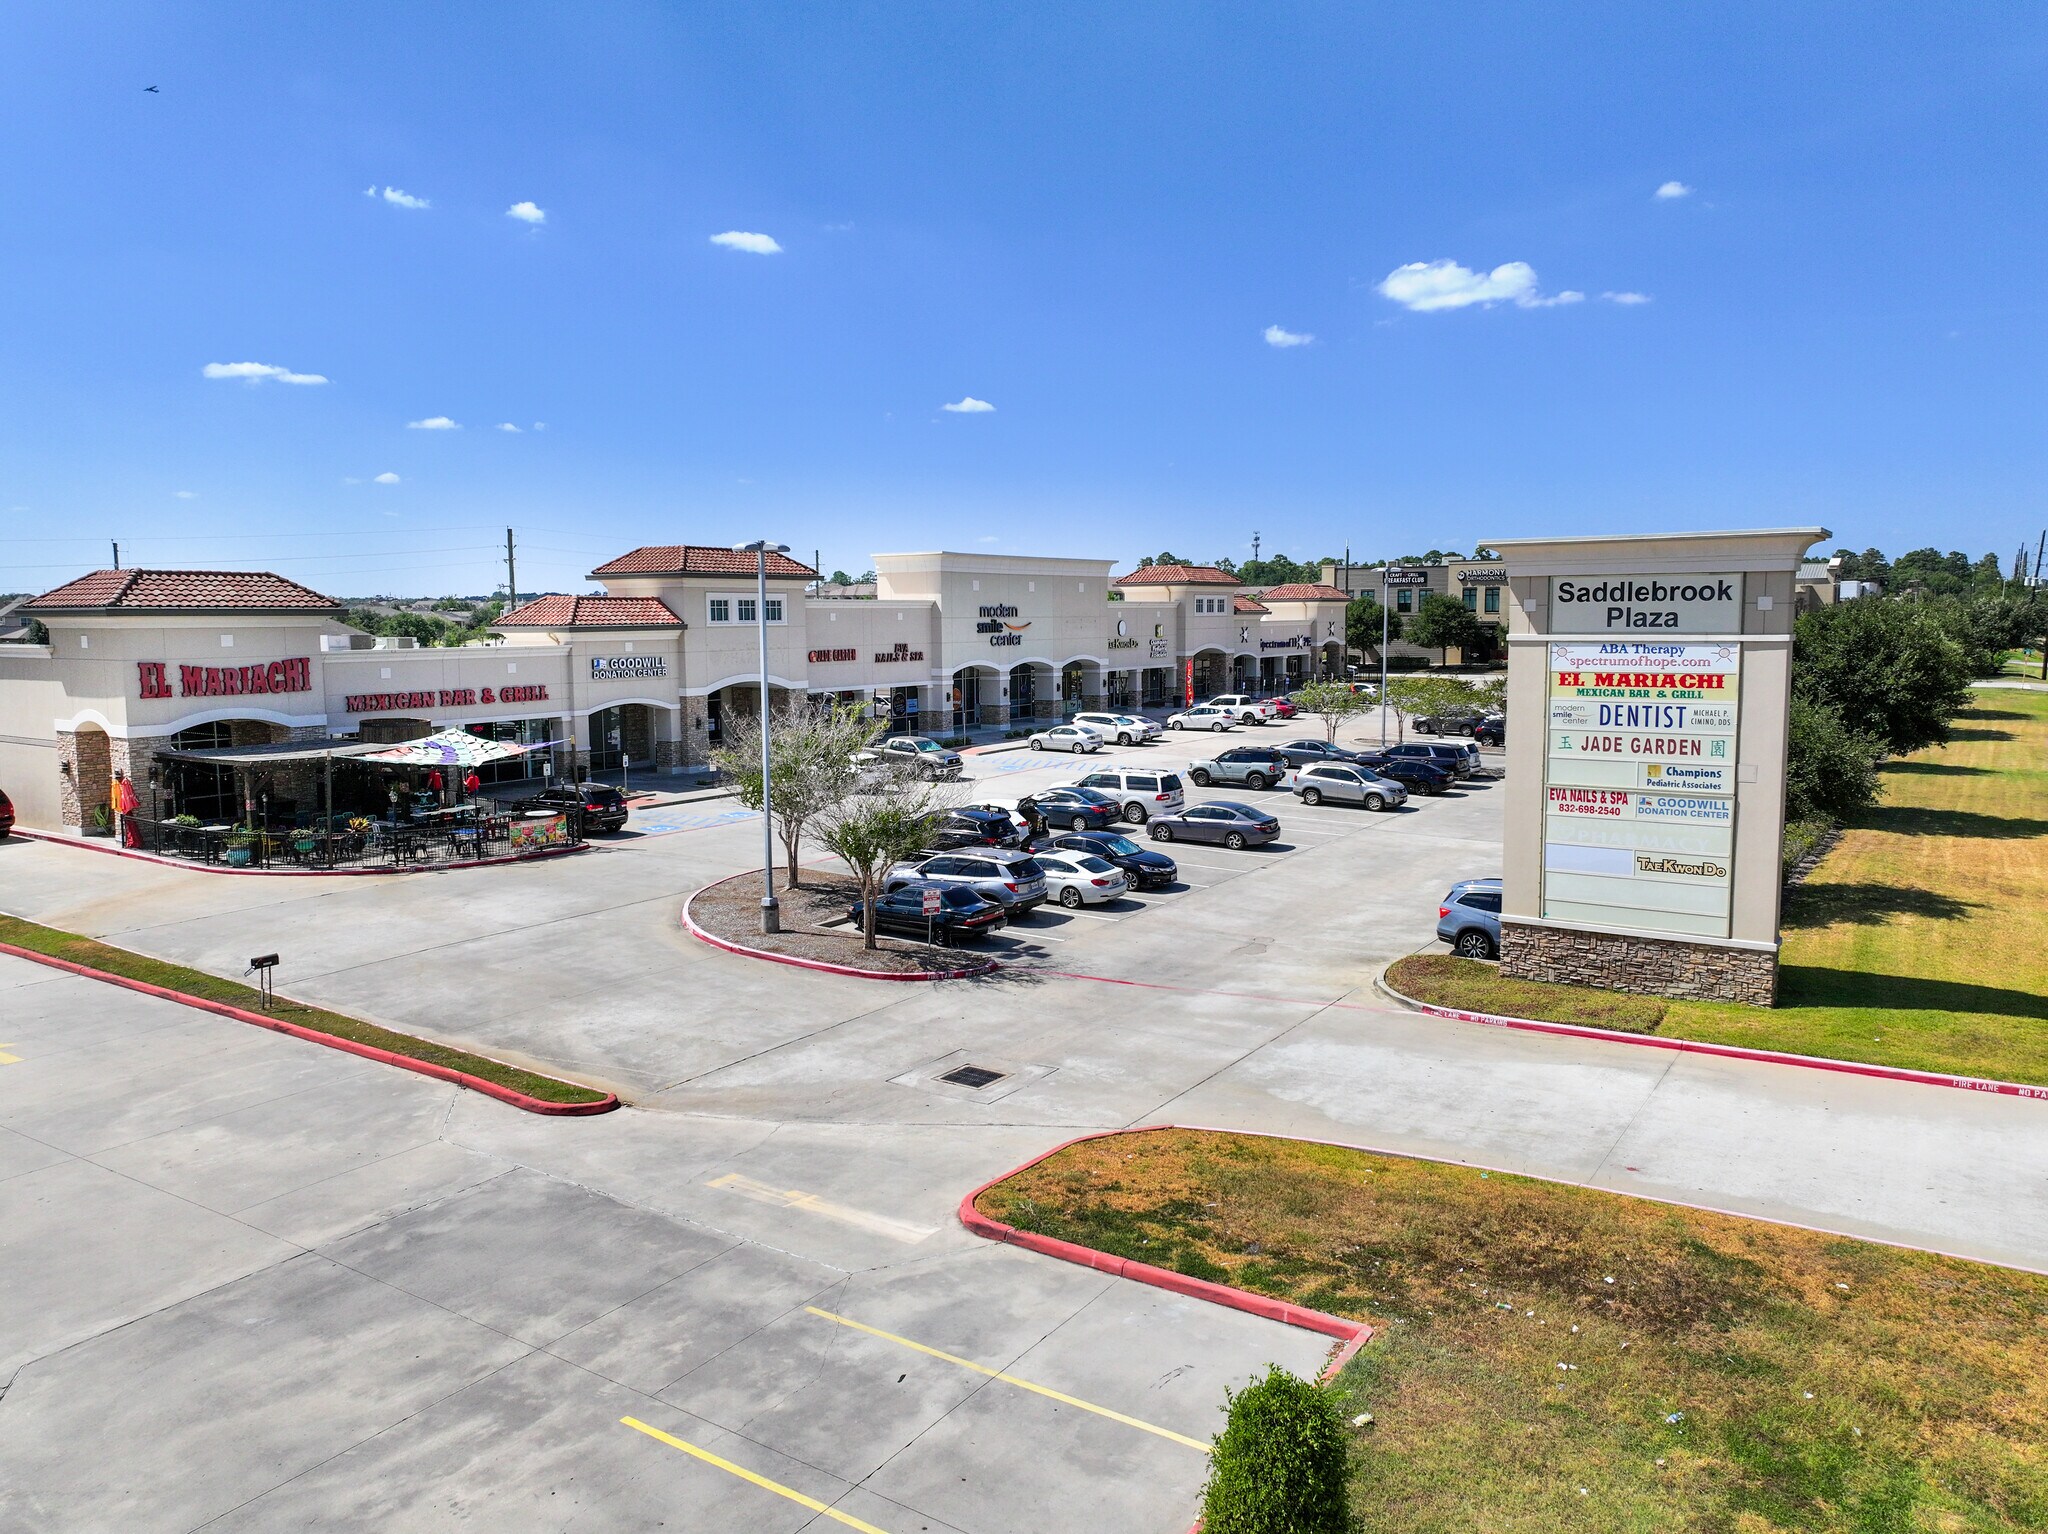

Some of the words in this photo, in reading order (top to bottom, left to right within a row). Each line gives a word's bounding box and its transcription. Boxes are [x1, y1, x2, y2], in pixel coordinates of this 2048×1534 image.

[1466, 568, 1506, 577] HARMONY
[1558, 580, 1733, 603] Saddlebrook
[979, 603, 1018, 618] modern
[1607, 607, 1679, 628] Plaza
[976, 619, 1003, 633] smile
[990, 632, 1022, 646] center
[1599, 644, 1628, 654] ABA
[1631, 644, 1686, 657] Therapy
[609, 656, 668, 669] GOODWILL
[1570, 655, 1711, 670] spectrumofhope.com
[137, 661, 173, 699] EL
[179, 657, 312, 697] MARIACHI
[592, 669, 636, 680] DONATION
[637, 667, 668, 678] CENTER
[1558, 672, 1585, 687] EL
[1594, 673, 1725, 689] MARIACHI
[345, 690, 436, 712] MEXICAN
[439, 688, 477, 707] BAR
[481, 687, 496, 704] &
[500, 685, 550, 703] GRILL
[1576, 688, 1625, 698] MEXICAN
[1629, 689, 1650, 698] BAR
[1656, 690, 1667, 698] &
[1671, 689, 1704, 699] GRILL
[1554, 704, 1586, 712] modern
[1693, 709, 1720, 717] MICHAEL
[1562, 717, 1588, 725] center
[1599, 704, 1687, 729] DENTIST
[1690, 717, 1717, 726] CIMINO,
[1718, 718, 1731, 726] DDS
[1558, 735, 1573, 750] 玉
[1581, 736, 1623, 752] JADE
[1631, 738, 1702, 756] GARDEN
[1666, 766, 1722, 779] Champions
[1646, 778, 1680, 788] Pediatric
[1682, 780, 1722, 790] Associates
[1550, 788, 1567, 801] EVA
[1570, 789, 1597, 804] NAILS
[1600, 790, 1607, 804] &
[1610, 791, 1629, 805] SPA
[1657, 797, 1729, 811] GOODWILL
[1637, 807, 1688, 817] DONATION
[1690, 810, 1729, 819] CENTER
[1444, 1011, 1461, 1020] LANE
[1470, 1015, 1478, 1023] NO
[1480, 1016, 1508, 1027] PARKING
[1953, 1079, 1973, 1089] FIRE
[1976, 1082, 2000, 1093] LANE
[2018, 1088, 2031, 1097] NO
